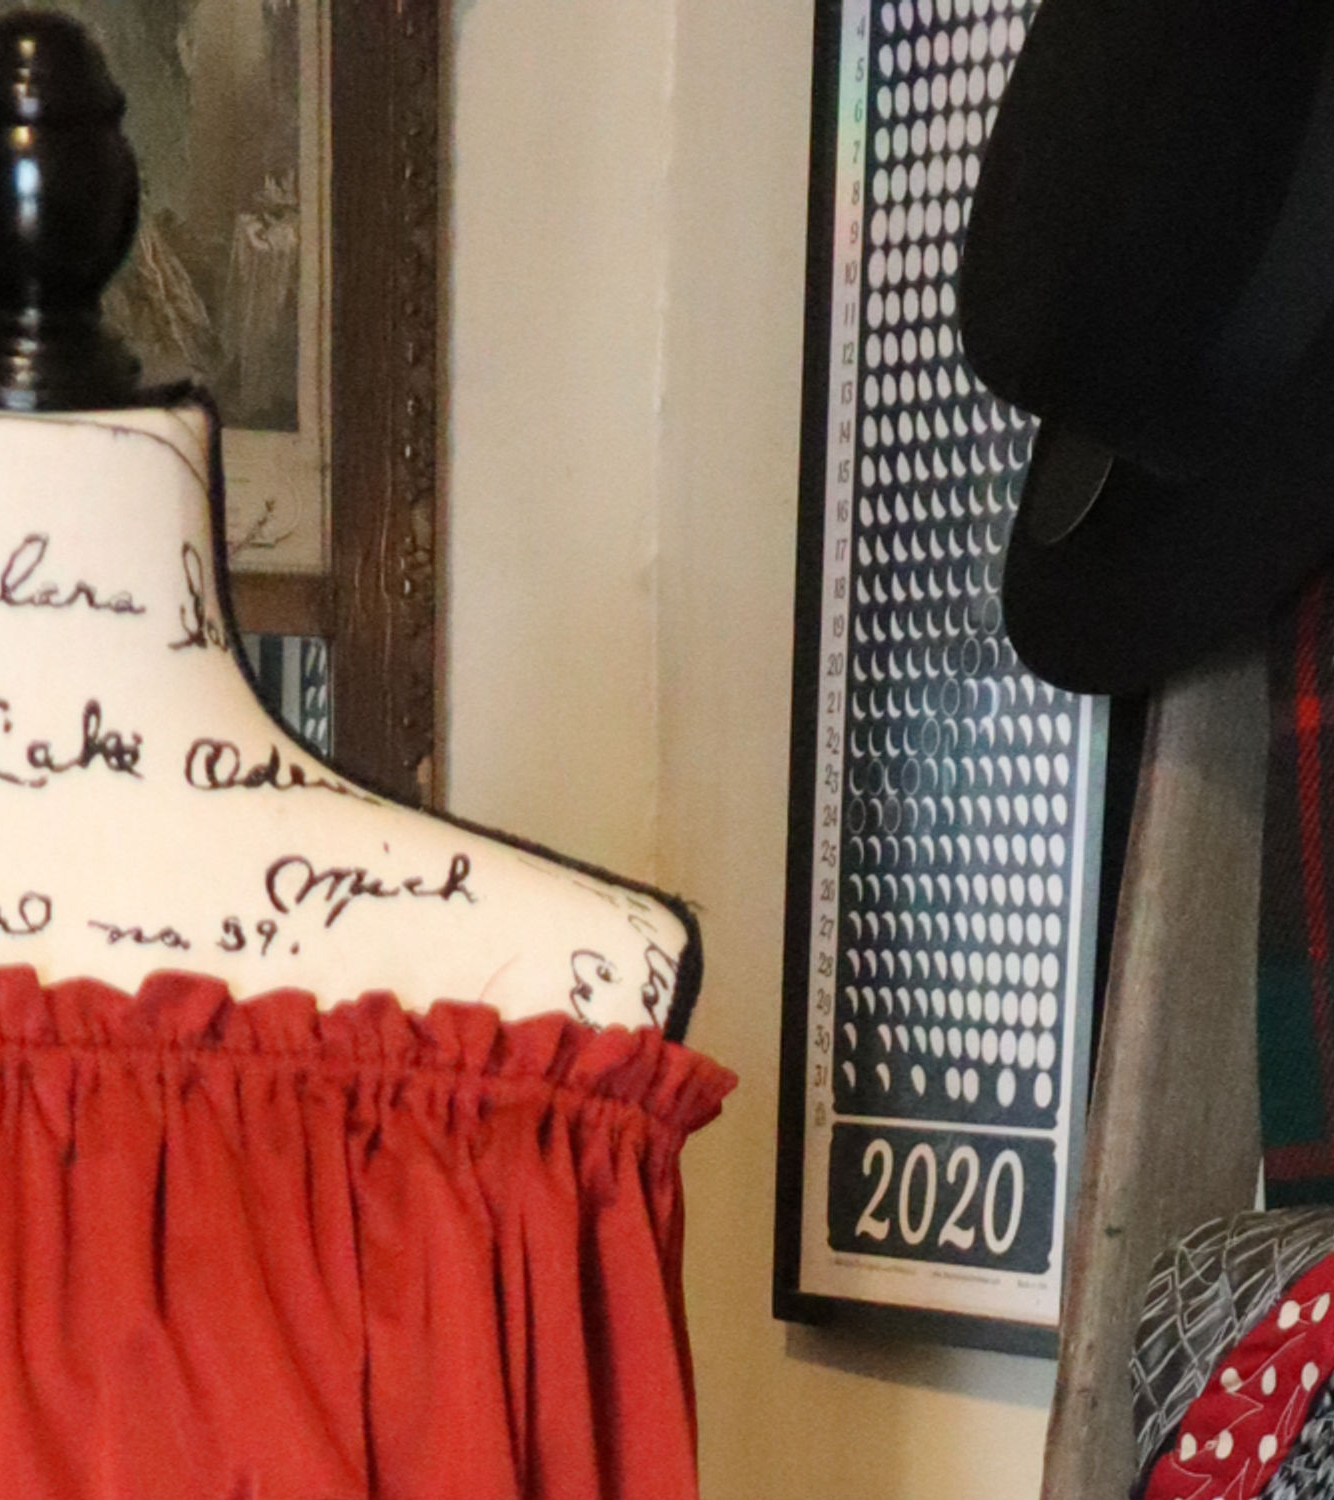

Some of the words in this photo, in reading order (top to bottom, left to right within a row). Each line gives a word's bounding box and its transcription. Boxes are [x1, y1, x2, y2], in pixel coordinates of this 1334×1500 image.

[855, 57, 865, 82] 5
[854, 99, 863, 123] 6
[852, 140, 861, 164] 7
[851, 181, 860, 205] 8
[850, 221, 859, 245] 9
[844, 261, 857, 285] 10
[843, 302, 856, 326] 11
[841, 342, 854, 365] 12
[840, 381, 853, 405] 13
[837, 460, 850, 484] 15
[836, 499, 849, 523] 16
[835, 539, 848, 561] 17
[833, 576, 846, 600] 18
[832, 615, 845, 638] 19
[826, 653, 844, 677] 20
[826, 691, 842, 714] 21
[825, 726, 840, 755] 22
[824, 763, 839, 794] 23
[822, 804, 838, 828] 24
[820, 840, 837, 868] 25
[819, 914, 834, 941] 27
[817, 951, 834, 978] 28
[816, 988, 831, 1016] 29
[814, 1024, 830, 1054] 30
[814, 1063, 828, 1088] 31
[854, 1137, 1025, 1255] 2020
